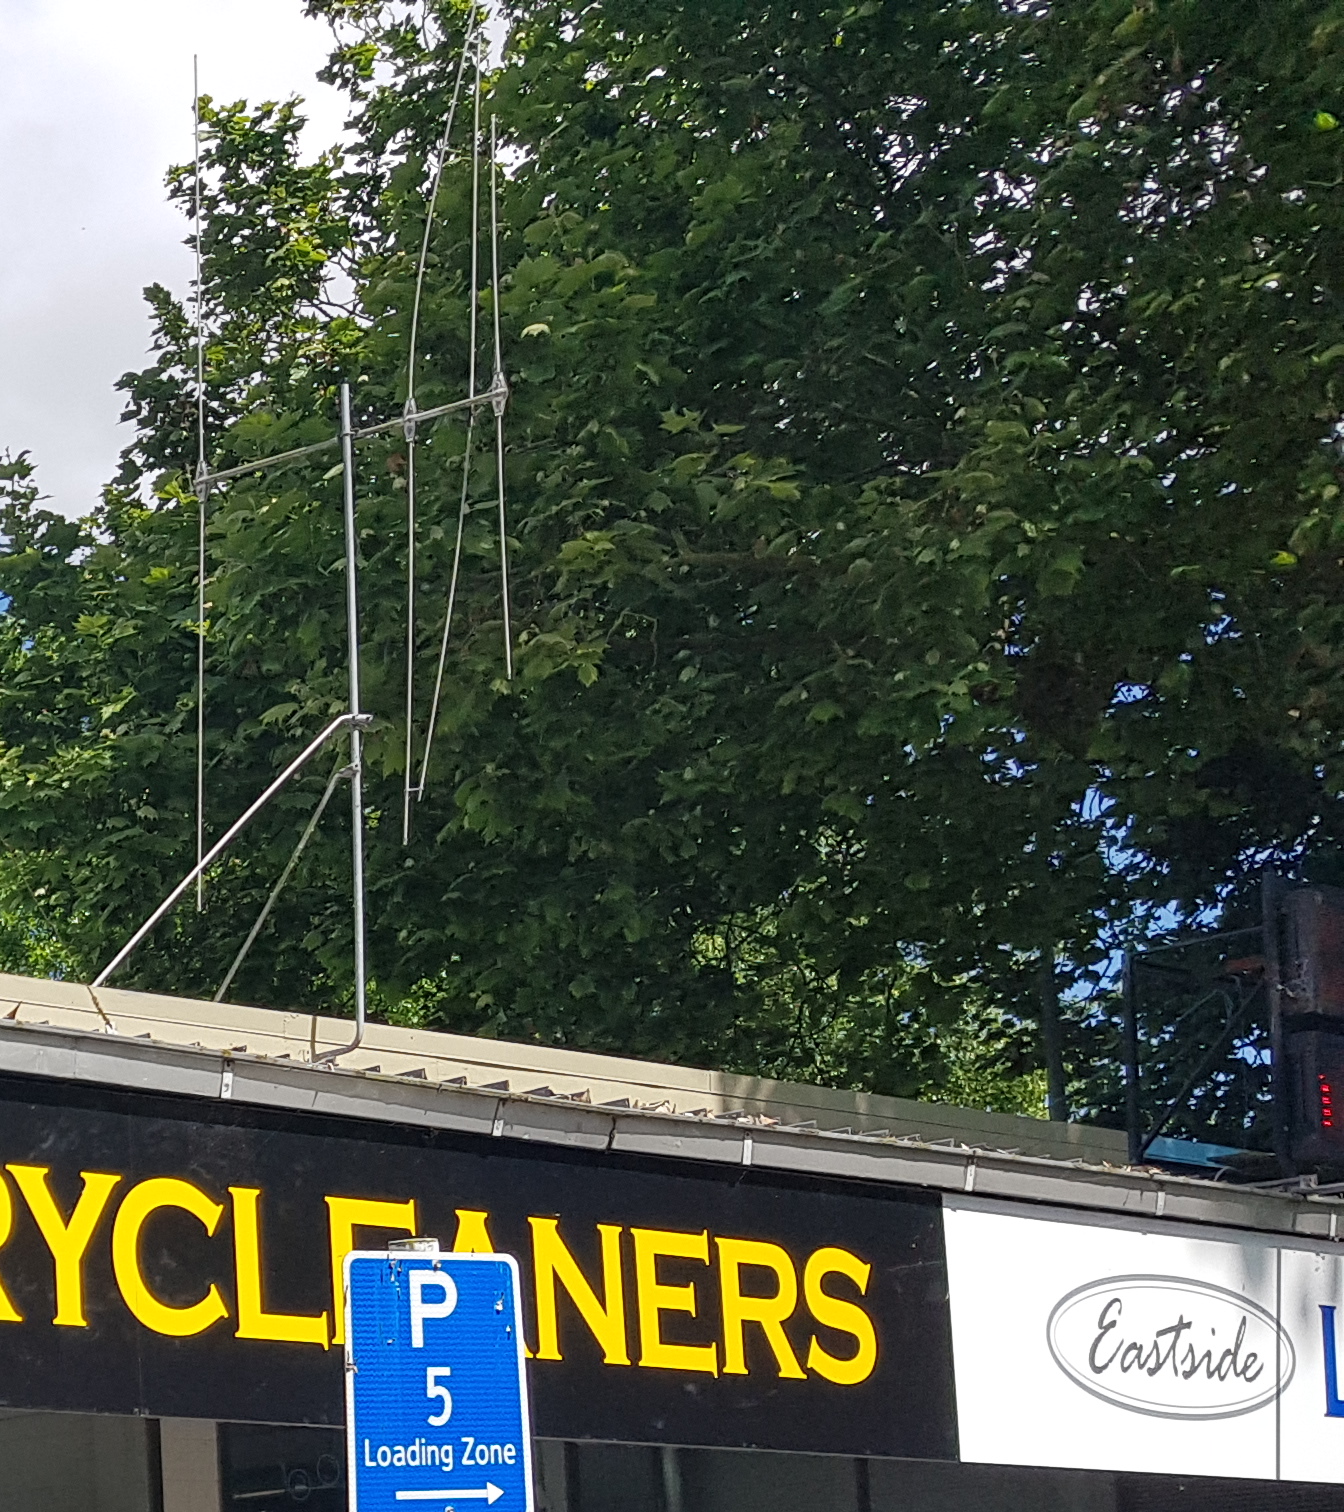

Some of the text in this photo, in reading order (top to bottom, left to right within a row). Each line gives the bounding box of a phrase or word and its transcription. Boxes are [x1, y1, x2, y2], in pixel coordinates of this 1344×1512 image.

[409, 1269, 458, 1349] P
[1088, 1297, 1265, 1383] Eastside
[426, 1366, 453, 1427] 5
[364, 1437, 517, 1472] Loading Zone
